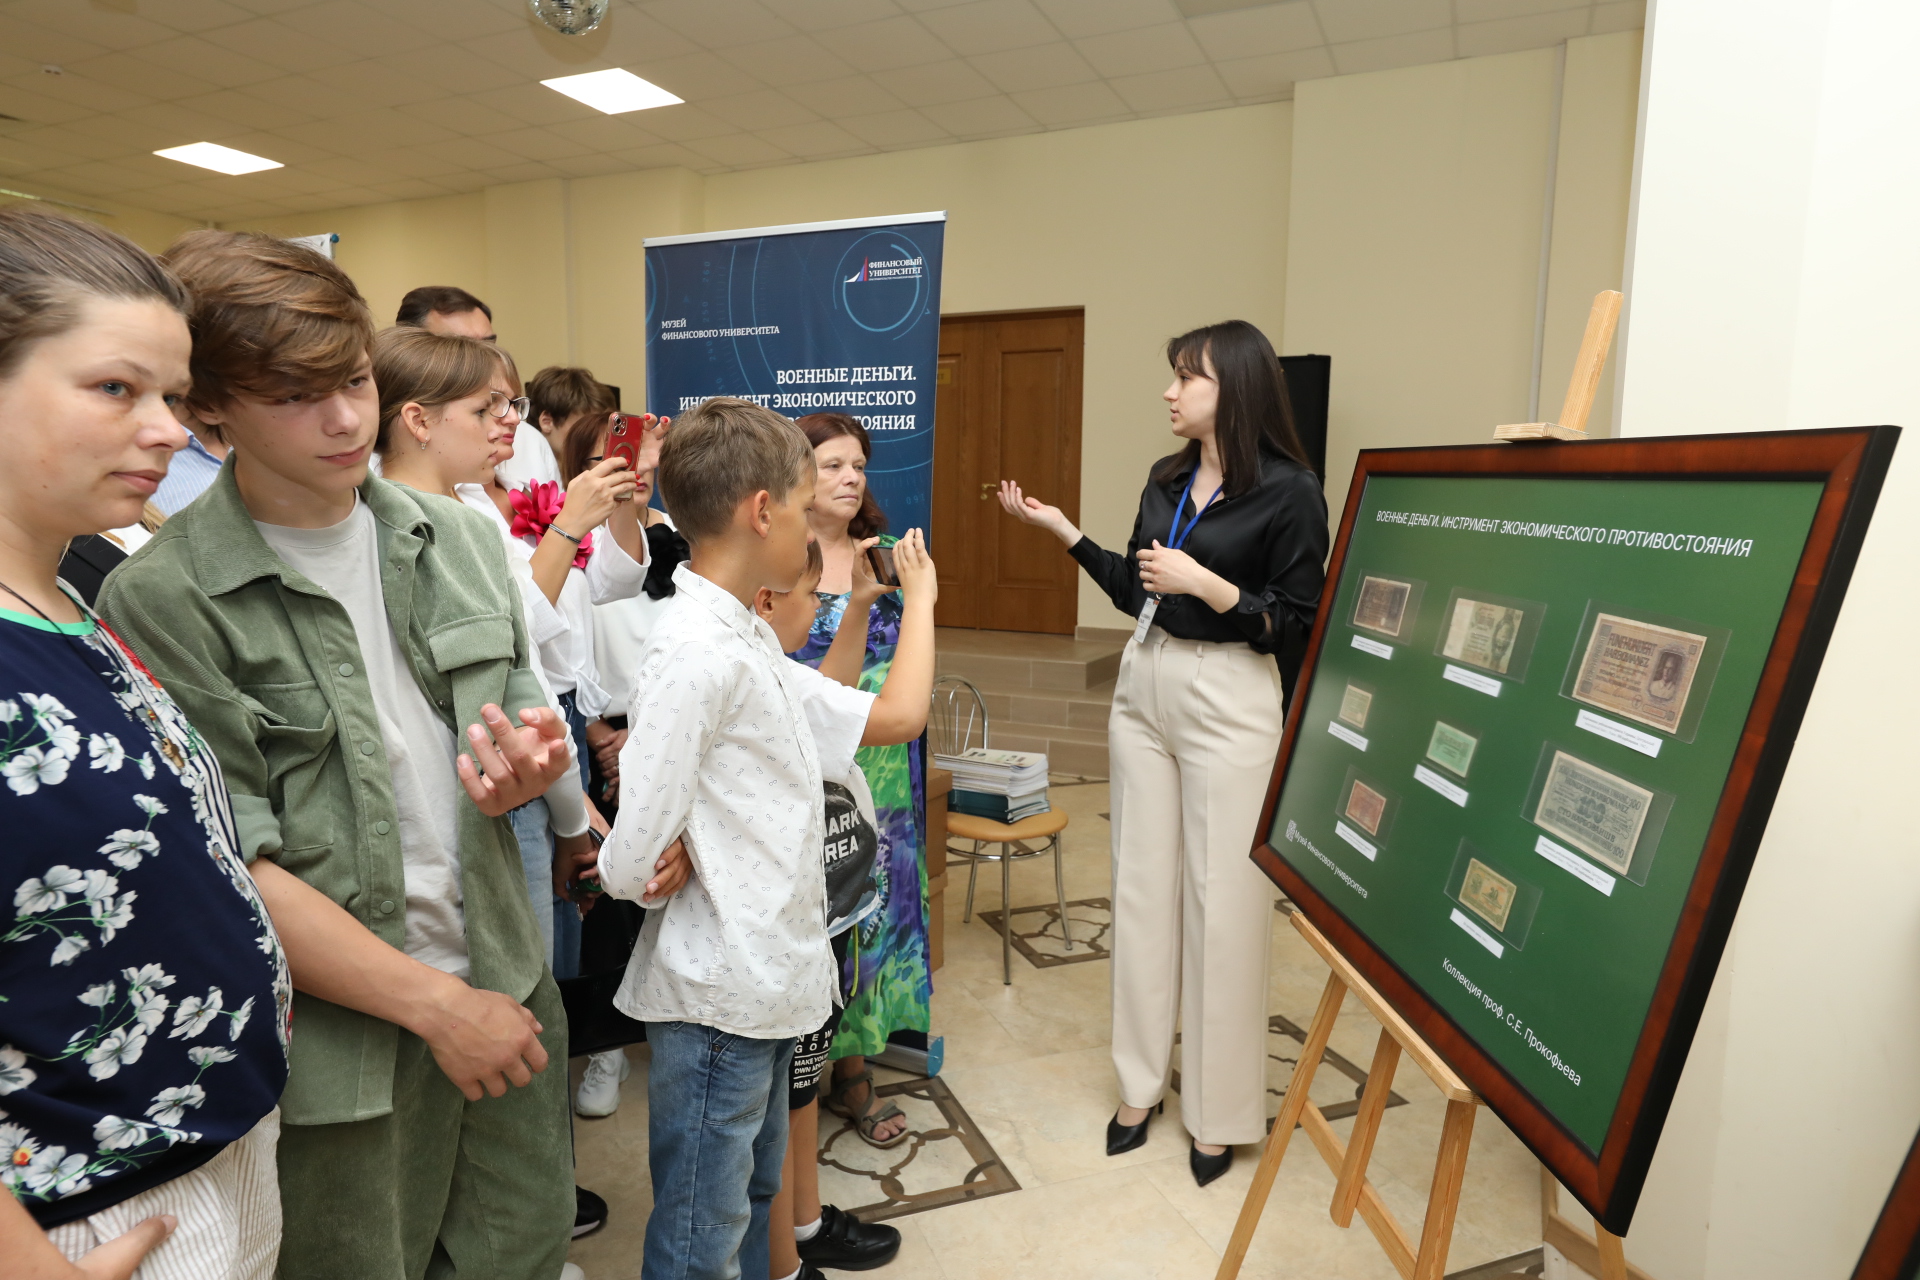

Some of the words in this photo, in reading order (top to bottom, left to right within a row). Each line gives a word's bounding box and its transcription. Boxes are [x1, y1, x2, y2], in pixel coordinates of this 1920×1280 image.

[869, 256, 922, 269] ФИНАНСОВЫЙ
[869, 267, 922, 277] УНИВЕРСИТЕТ
[661, 318, 687, 329] МУЗЕЙ
[661, 329, 719, 341] ФИНАНСОВОГО
[719, 325, 780, 338] УНИВЕРСИТЕТА
[776, 367, 849, 385] ВОЕННЫЕ
[850, 365, 917, 386] ДЕНЬГИ.
[772, 390, 917, 408] ЭКОНОМИЧЕСКОГО
[1376, 510, 1410, 524] ВОЕННЫЕ
[1407, 512, 1440, 528] ДЕНЬГИ.
[1441, 515, 1500, 533] ИНСТРУМЕНТ
[1500, 520, 1606, 543] ЭКОНОМИЧЕСКОГО
[1607, 528, 1754, 557] ПРОТИВОСТОЯНИЯ
[1575, 792, 1607, 825] 100
[825, 808, 860, 837] ARK
[824, 834, 859, 864] REA
[1294, 829, 1308, 848] Музей
[1334, 865, 1368, 899] университета
[1442, 957, 1482, 999] Коллекция
[1481, 994, 1504, 1020] проф.
[1506, 1013, 1523, 1036] С.Е.
[1524, 1028, 1582, 1087] Прокофьева
[794, 1040, 829, 1054] GOA
[794, 1057, 813, 1067] MAKE
[794, 1067, 811, 1075] OWN
[793, 1079, 811, 1090] REAL
